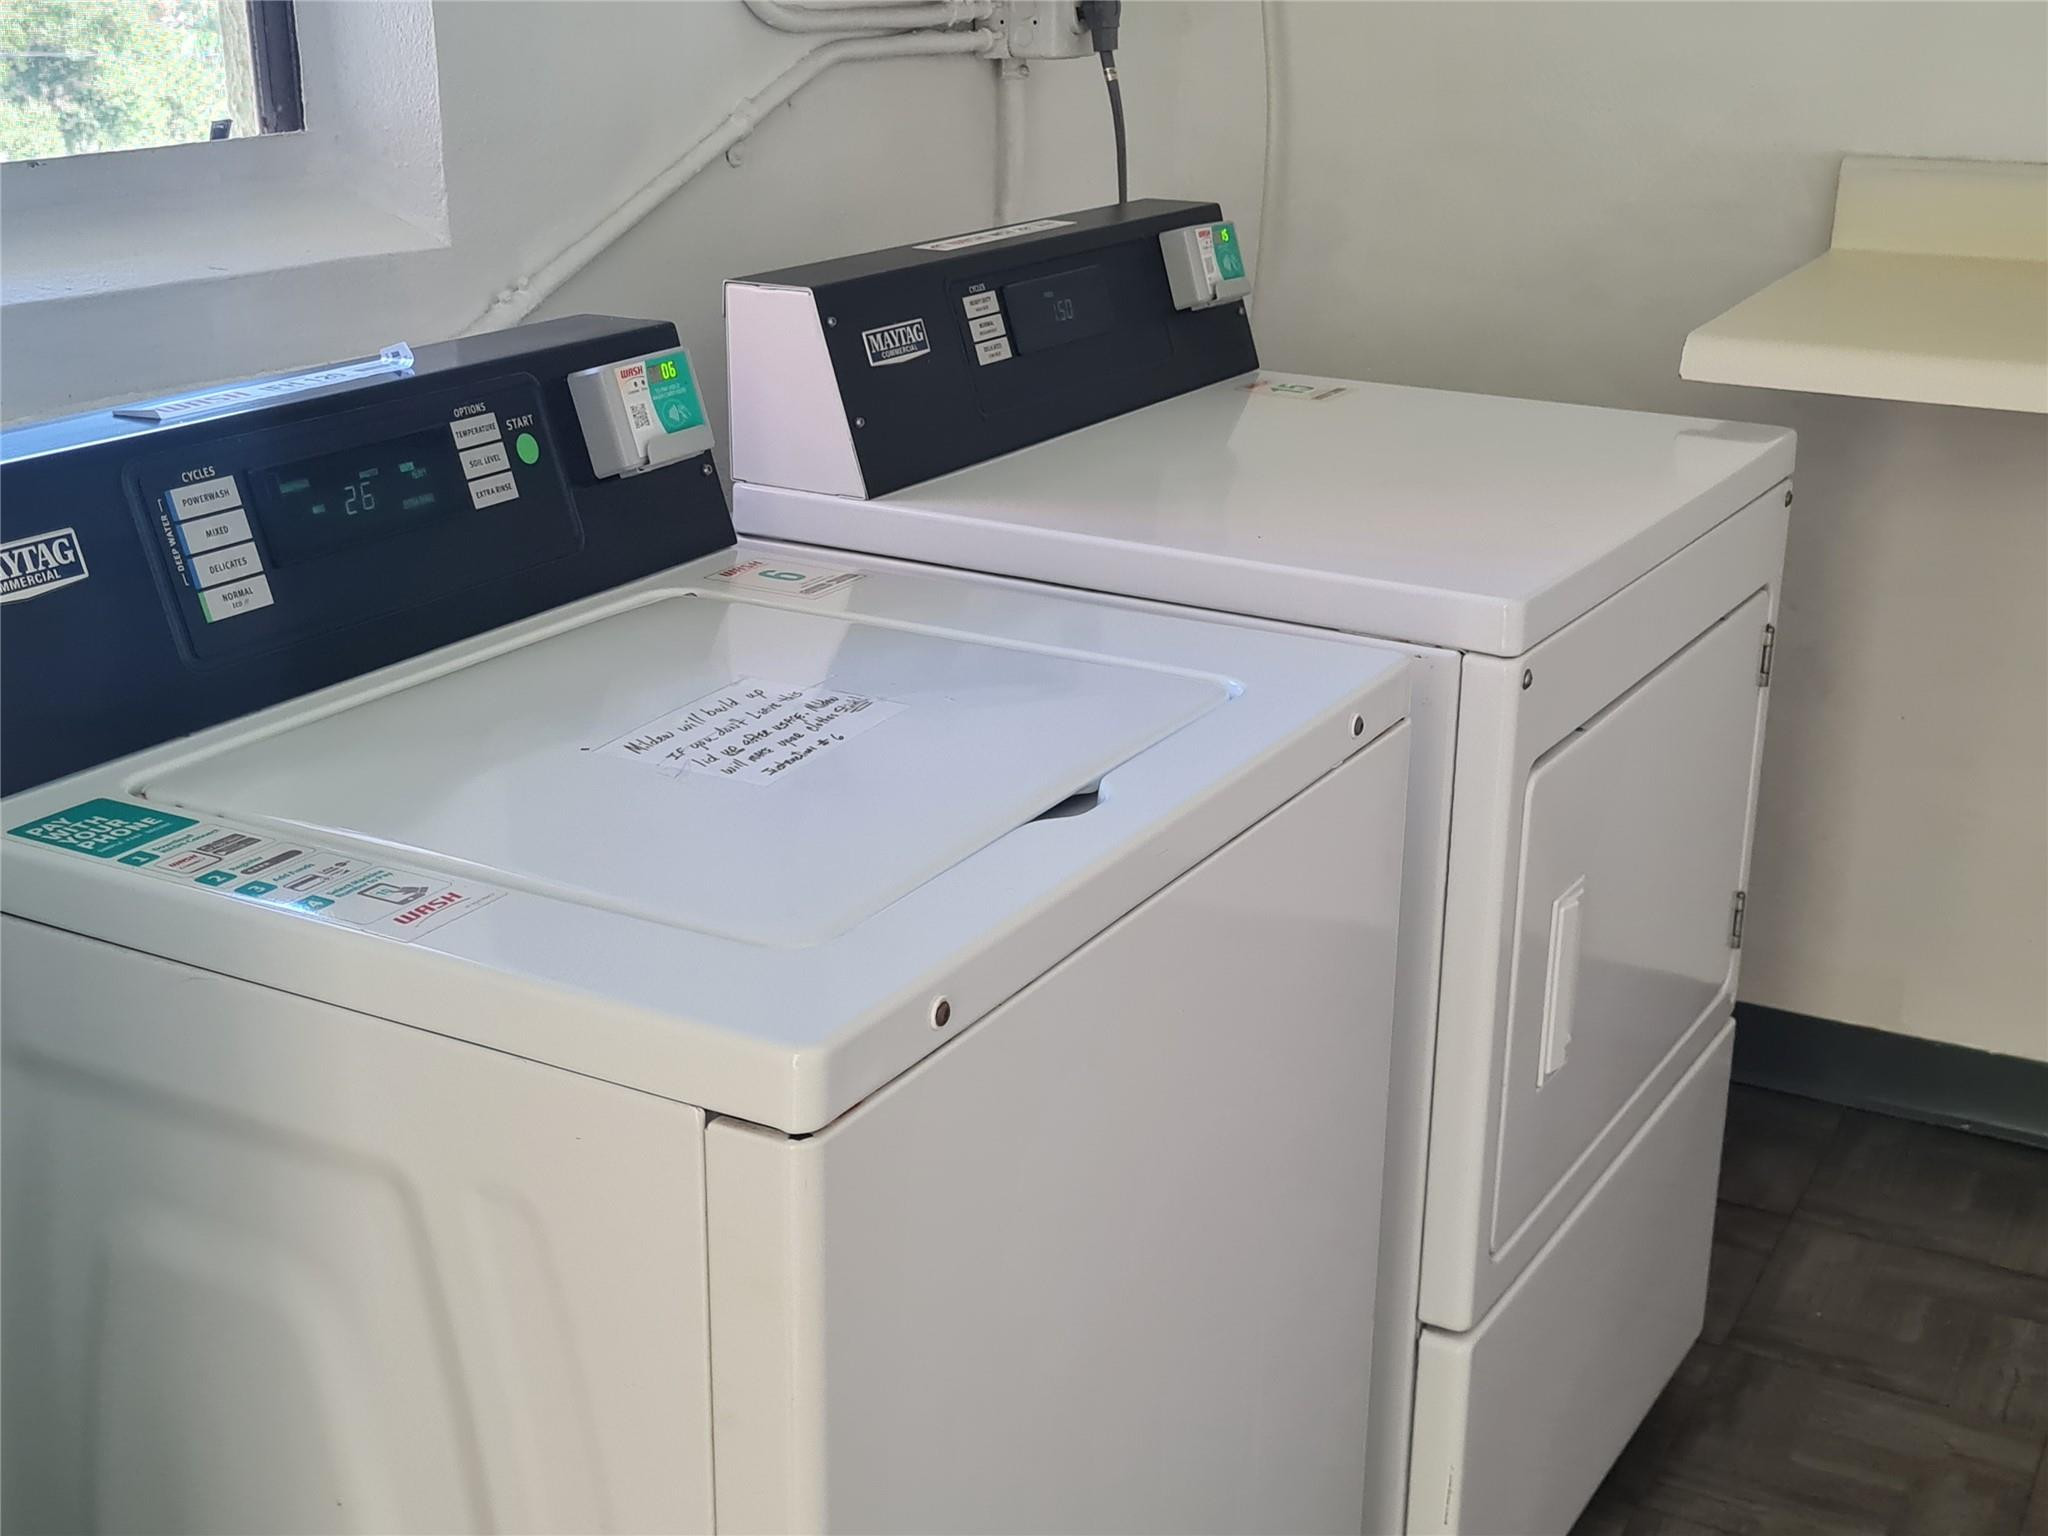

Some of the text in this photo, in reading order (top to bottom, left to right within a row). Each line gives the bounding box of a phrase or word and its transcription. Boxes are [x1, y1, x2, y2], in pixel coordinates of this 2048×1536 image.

[868, 324, 924, 353] MAYTAG
[620, 365, 643, 379] WASH
[660, 361, 677, 379] 06
[453, 402, 486, 418] OPTIONS
[455, 422, 496, 439] TEMPERATURE
[506, 414, 534, 431] START
[469, 454, 501, 468] SOIL LEVEL
[181, 466, 216, 482] CYCLES
[182, 488, 230, 507] POWERWASH
[344, 481, 375, 515] 26
[476, 482, 512, 499] EXTRA RINSE
[205, 525, 229, 539] MIXED
[160, 515, 185, 572] DEEP WATER
[209, 557, 248, 574] DELICATES
[758, 569, 806, 582] 6
[222, 587, 253, 602] NORMAL
[678, 712, 706, 732] will
[699, 697, 740, 717] build
[691, 754, 720, 768] lid
[25, 816, 72, 837] PAY
[42, 815, 109, 840] WITH
[58, 818, 129, 844] YOUR
[77, 817, 163, 850] PHONE
[133, 855, 149, 863] 1
[207, 871, 226, 882] 2
[248, 885, 266, 893] 3
[393, 892, 463, 924] WASH
